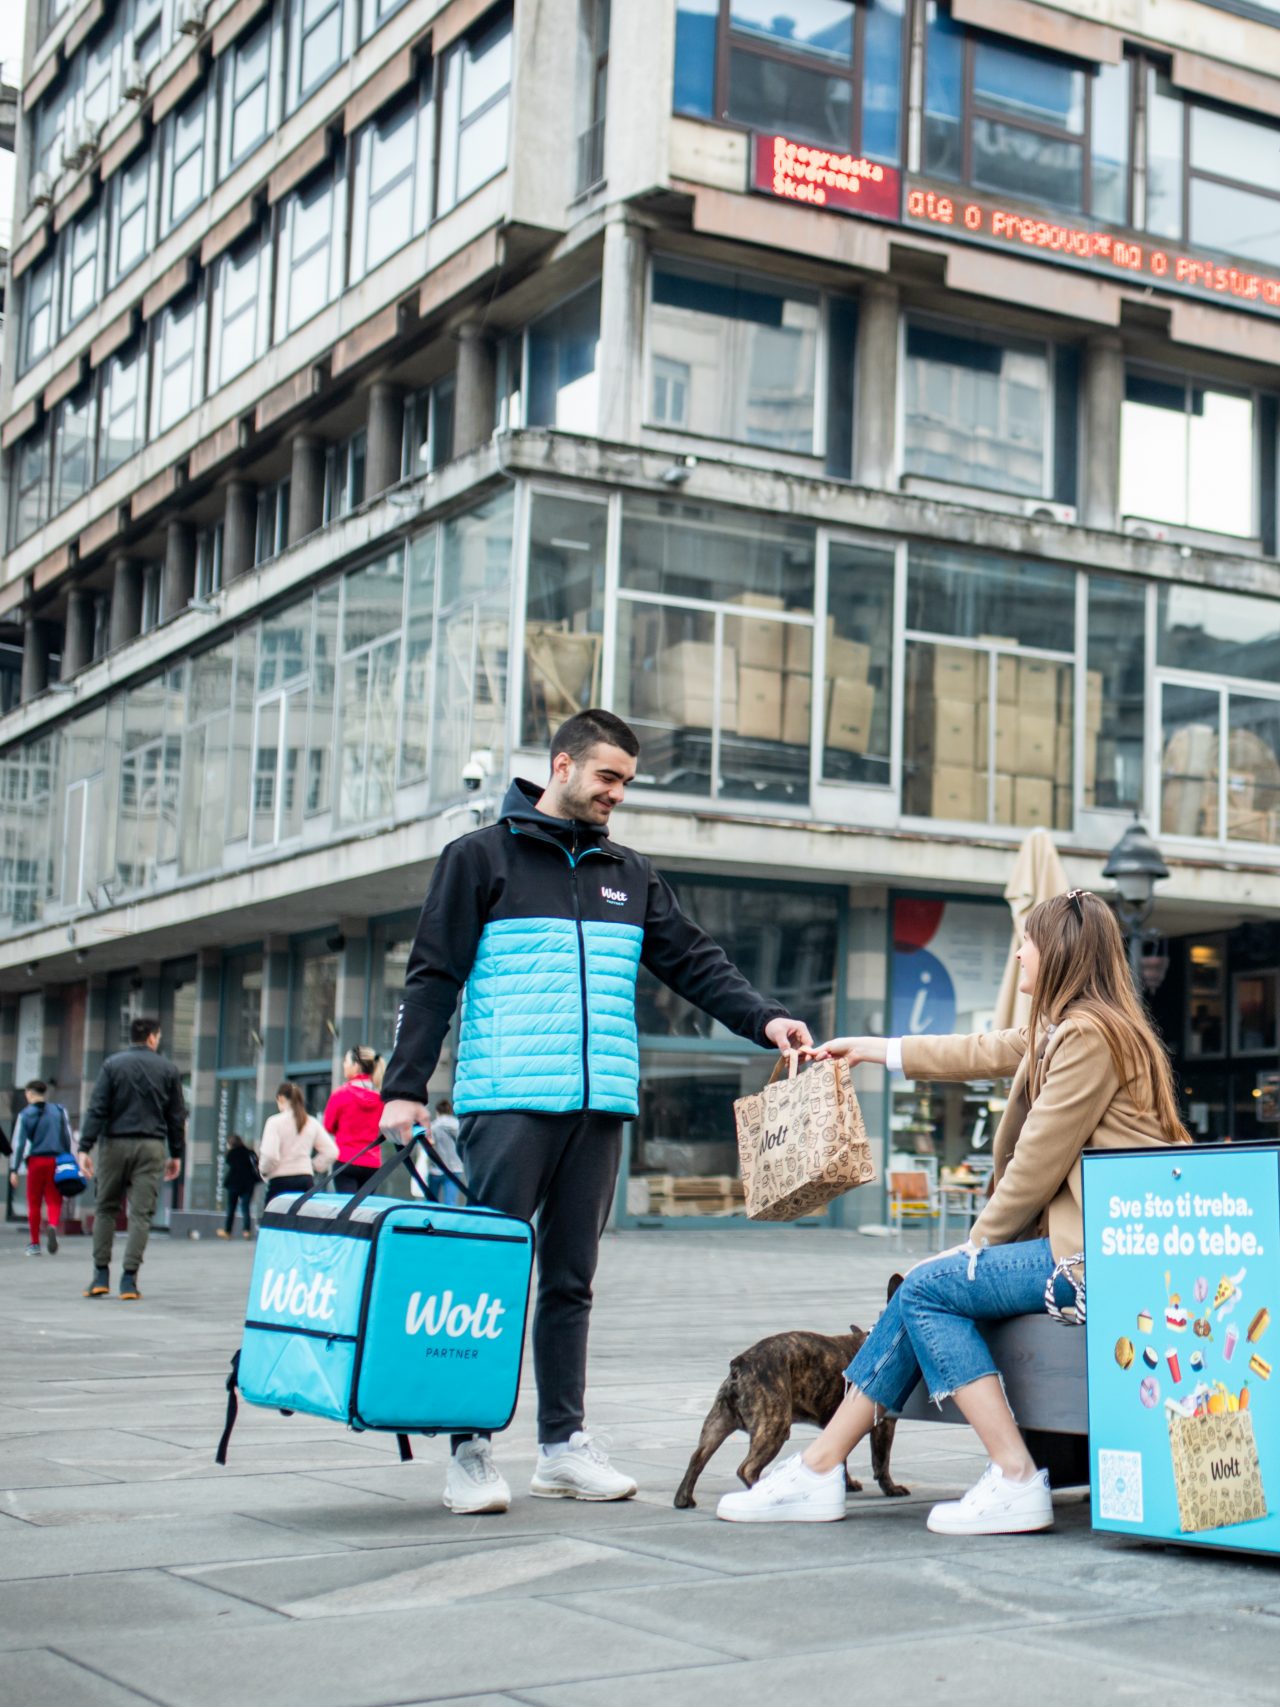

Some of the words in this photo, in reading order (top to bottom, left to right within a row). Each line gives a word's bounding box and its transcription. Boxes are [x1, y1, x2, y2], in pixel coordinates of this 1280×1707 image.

[601, 886, 628, 902] Wolt
[1109, 1196, 1142, 1219] Sve
[1145, 1193, 1174, 1218] što
[1176, 1192, 1191, 1217] ti
[1193, 1192, 1253, 1217] treba.
[1102, 1223, 1160, 1256] Stiže
[1163, 1225, 1195, 1255] do
[1198, 1224, 1264, 1256] tebe.
[260, 1268, 338, 1320] Wolt
[405, 1290, 506, 1339] Wolt
[425, 1347, 479, 1360] PARTNER
[1210, 1458, 1242, 1481] Wolt
